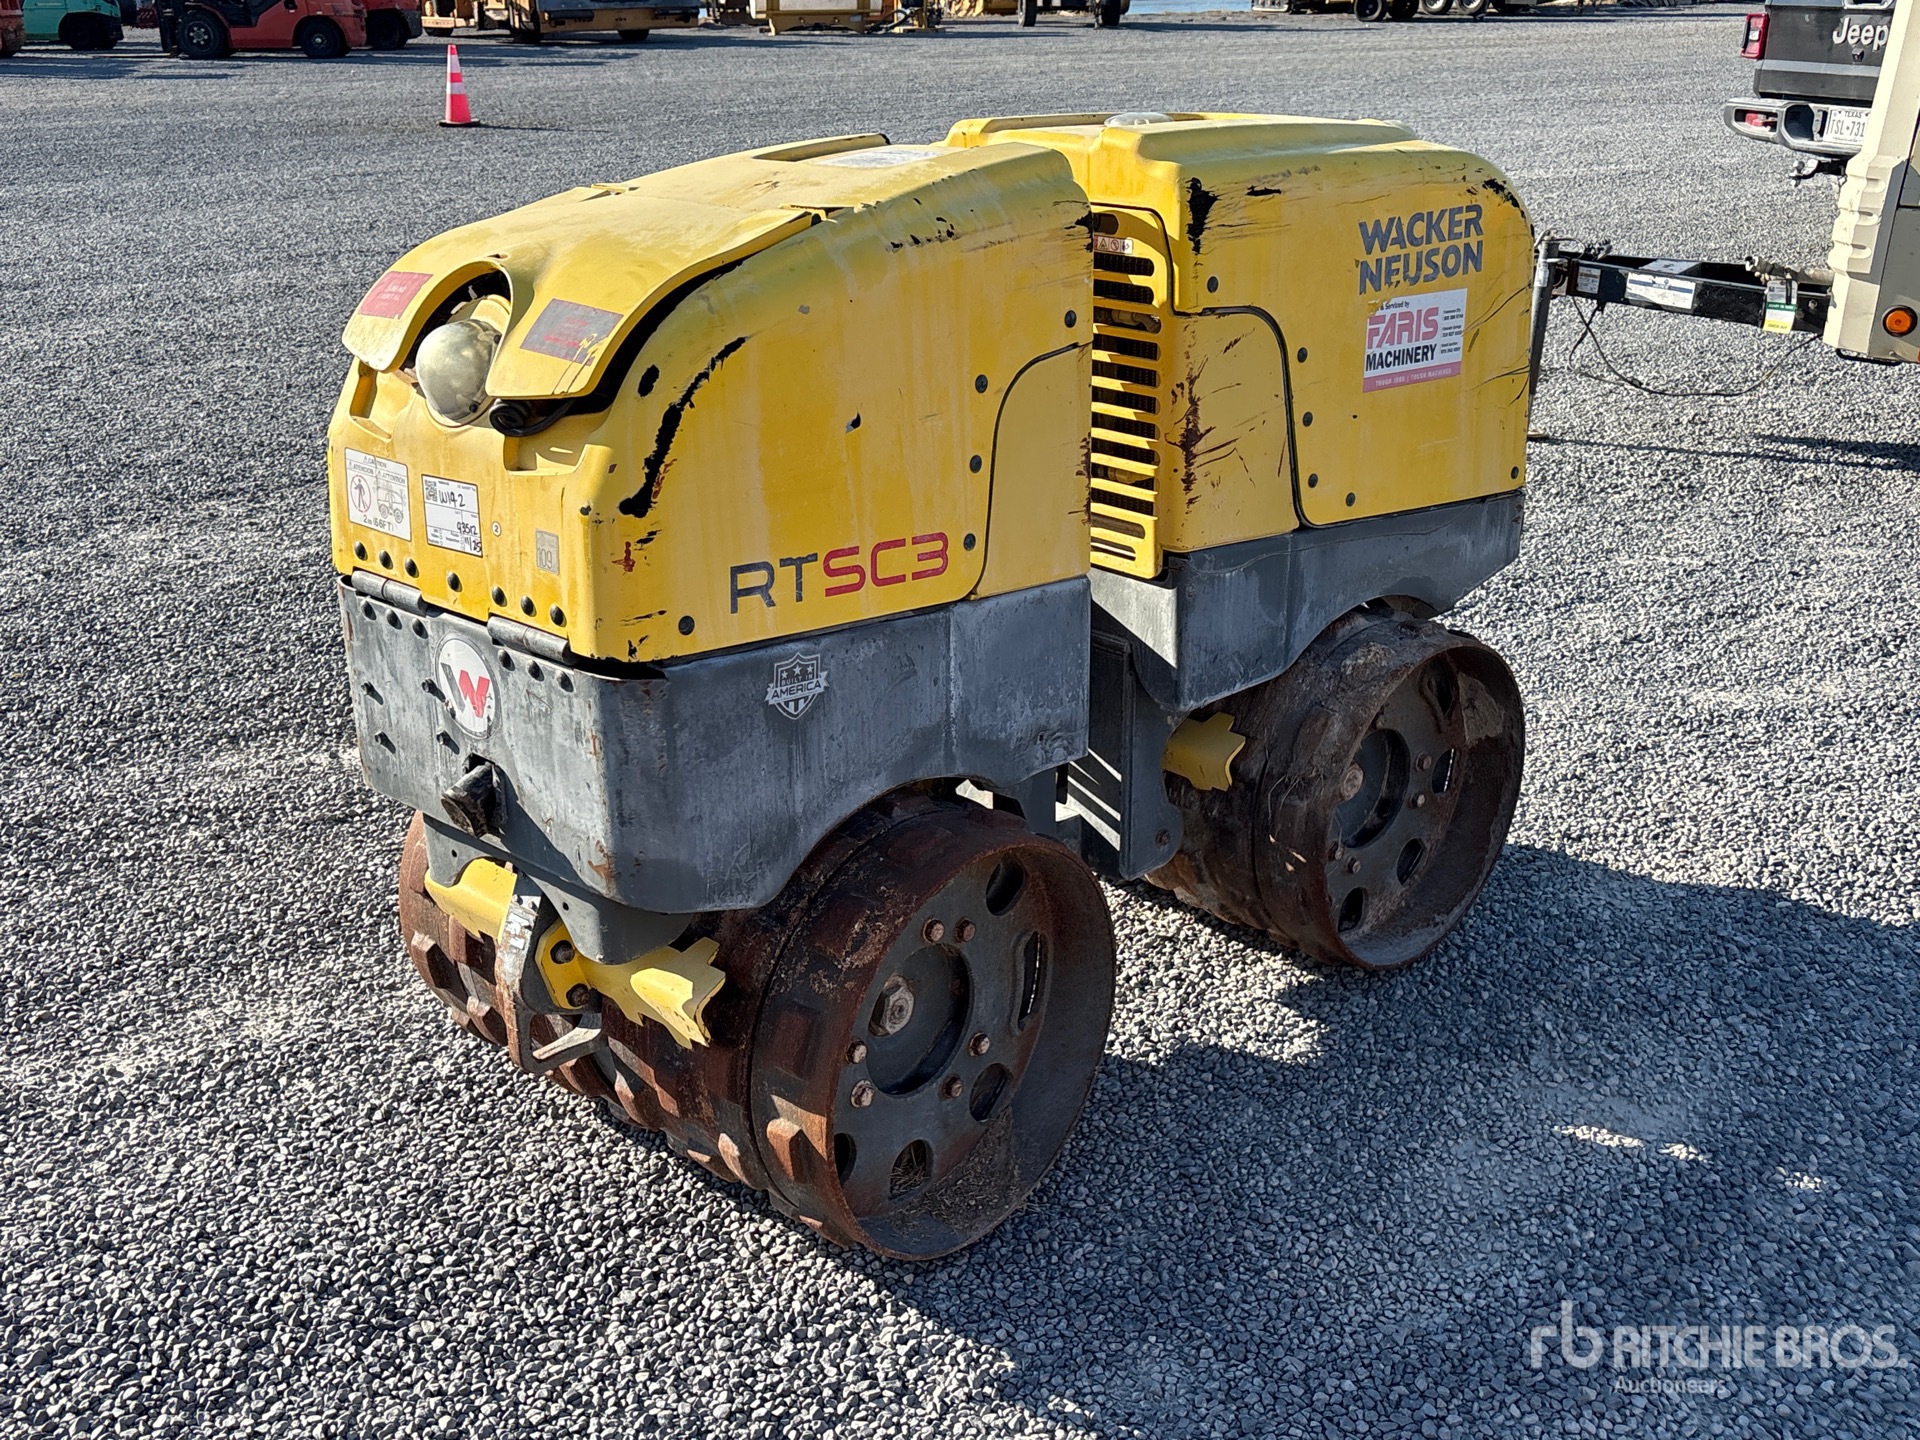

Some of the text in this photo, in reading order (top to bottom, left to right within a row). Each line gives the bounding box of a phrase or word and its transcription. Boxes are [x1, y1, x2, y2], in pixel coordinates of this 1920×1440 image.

[1832, 17, 1889, 51] Jeep
[1358, 204, 1484, 255] WACKER
[1359, 240, 1483, 295] NEUSON
[1367, 306, 1439, 349] FARIS
[1365, 343, 1437, 371] MACHINERY
[368, 457, 387, 468] CATION
[494, 524, 499, 533] 2
[771, 679, 821, 700] AMERICA
[781, 673, 813, 686] BUILT IN
